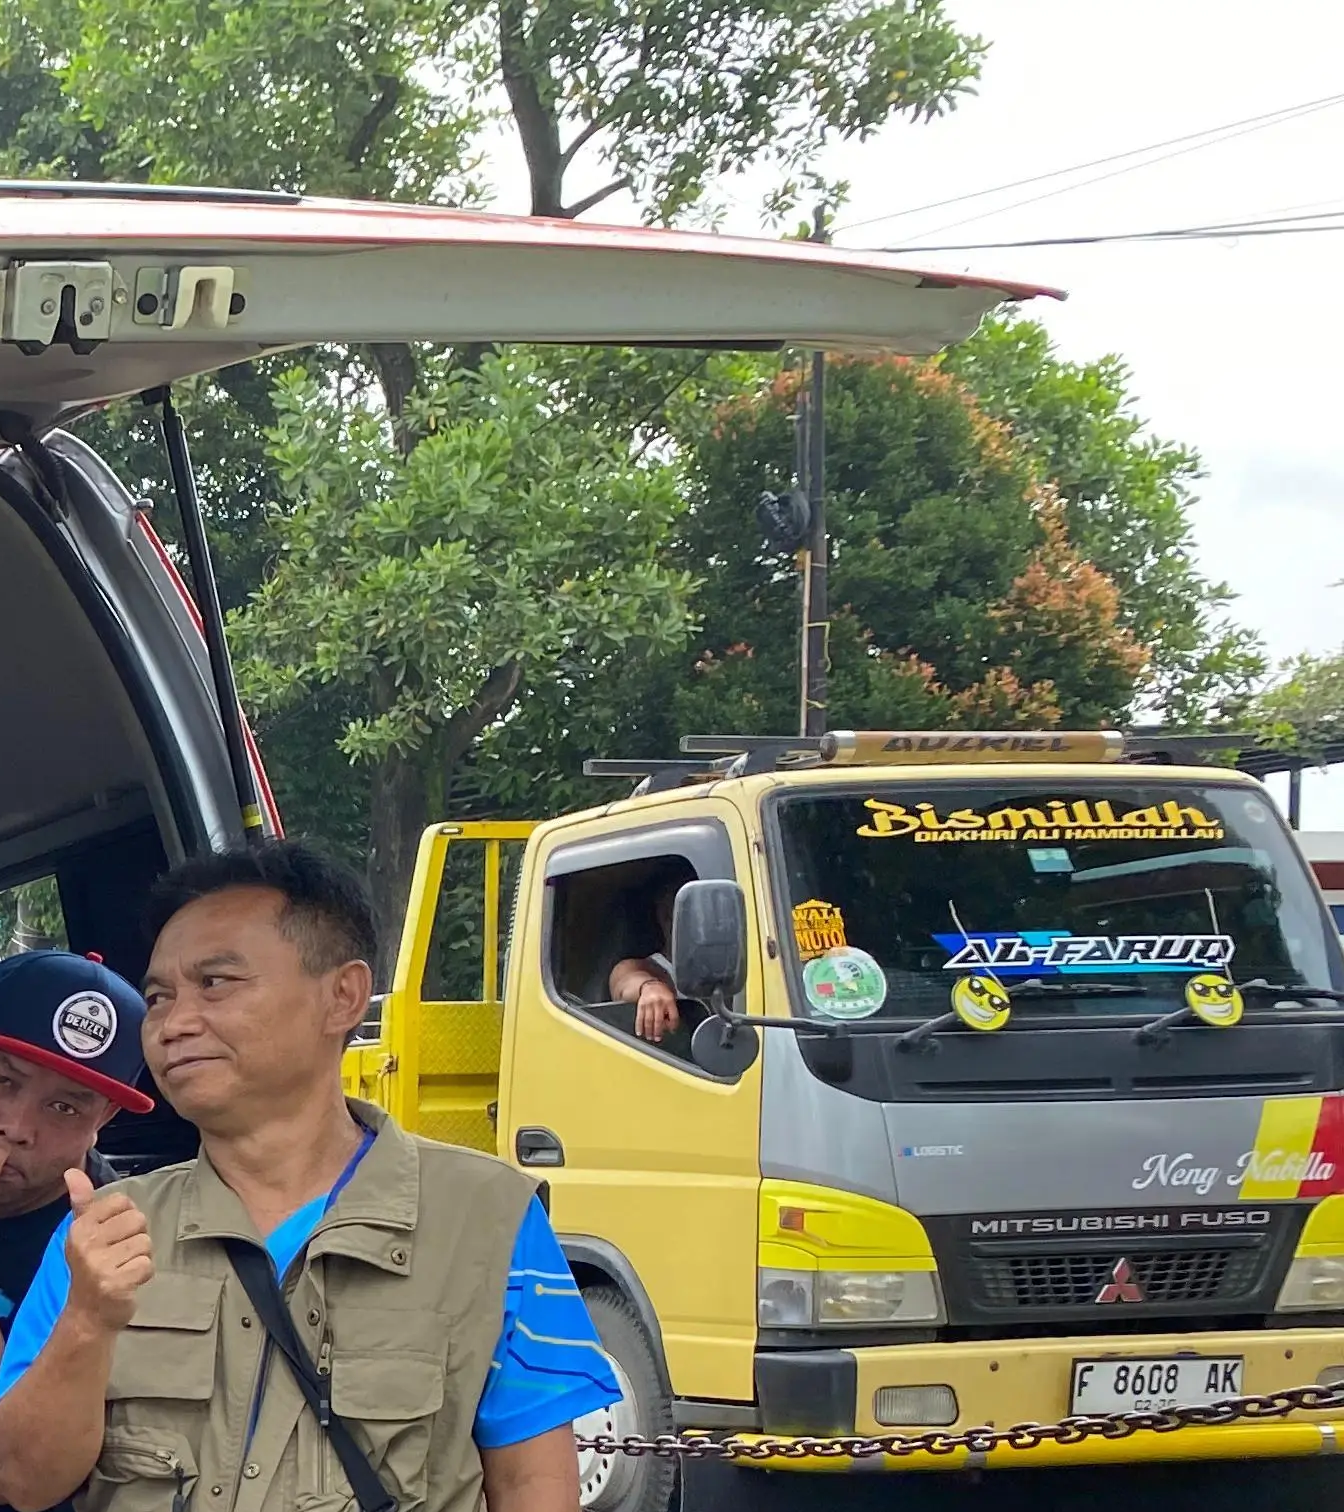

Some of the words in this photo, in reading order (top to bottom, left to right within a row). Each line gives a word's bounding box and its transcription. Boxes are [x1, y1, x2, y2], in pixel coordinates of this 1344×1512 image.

[857, 799, 1219, 837] Bismillah
[943, 935, 1235, 968] AL-FARUQ
[65, 1013, 105, 1039] DENZEL
[1132, 1153, 1219, 1196] Neng
[1227, 1150, 1335, 1186] Nabilla
[971, 1214, 1169, 1235] MITSUBISHI
[1180, 1211, 1271, 1228] FUSO
[1077, 1365, 1094, 1397] F
[1113, 1364, 1179, 1395] 8608
[1204, 1362, 1239, 1394] AK
